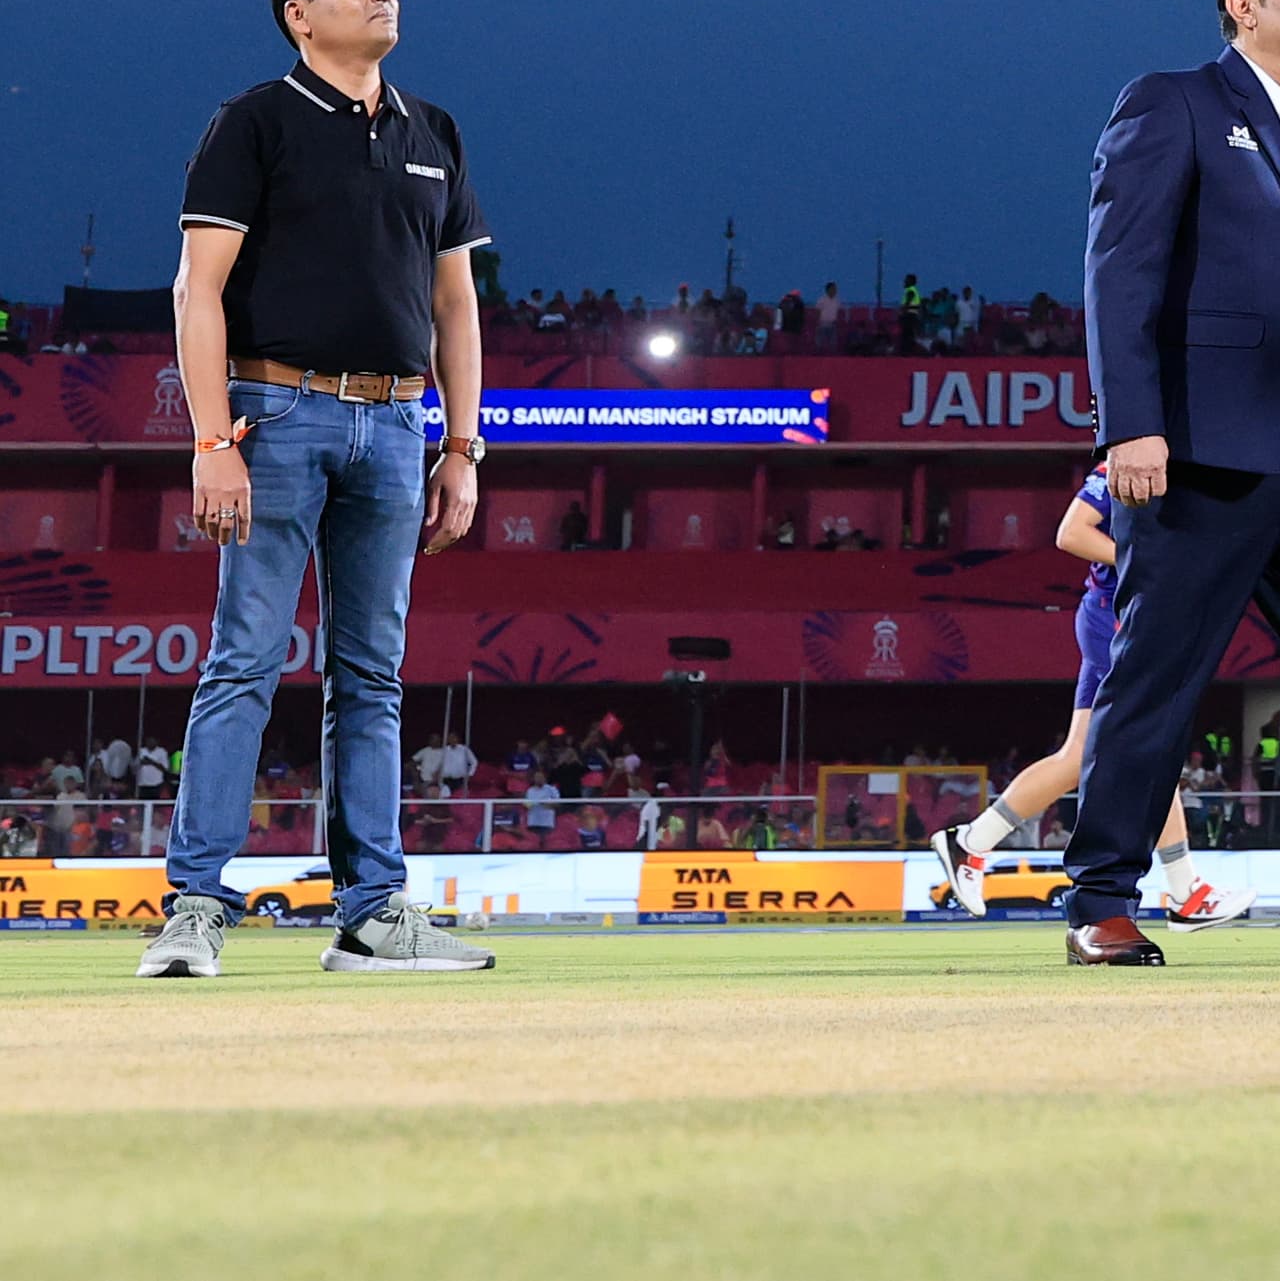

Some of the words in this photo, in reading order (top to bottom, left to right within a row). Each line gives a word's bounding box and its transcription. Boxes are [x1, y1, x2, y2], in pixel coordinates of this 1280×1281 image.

[480, 407, 510, 425] TO
[512, 407, 586, 425] SAWAI
[588, 407, 708, 426] MANSINGH
[711, 407, 811, 426] STADIUM
[674, 869, 731, 883] TATA
[672, 891, 854, 910] SIERRA
